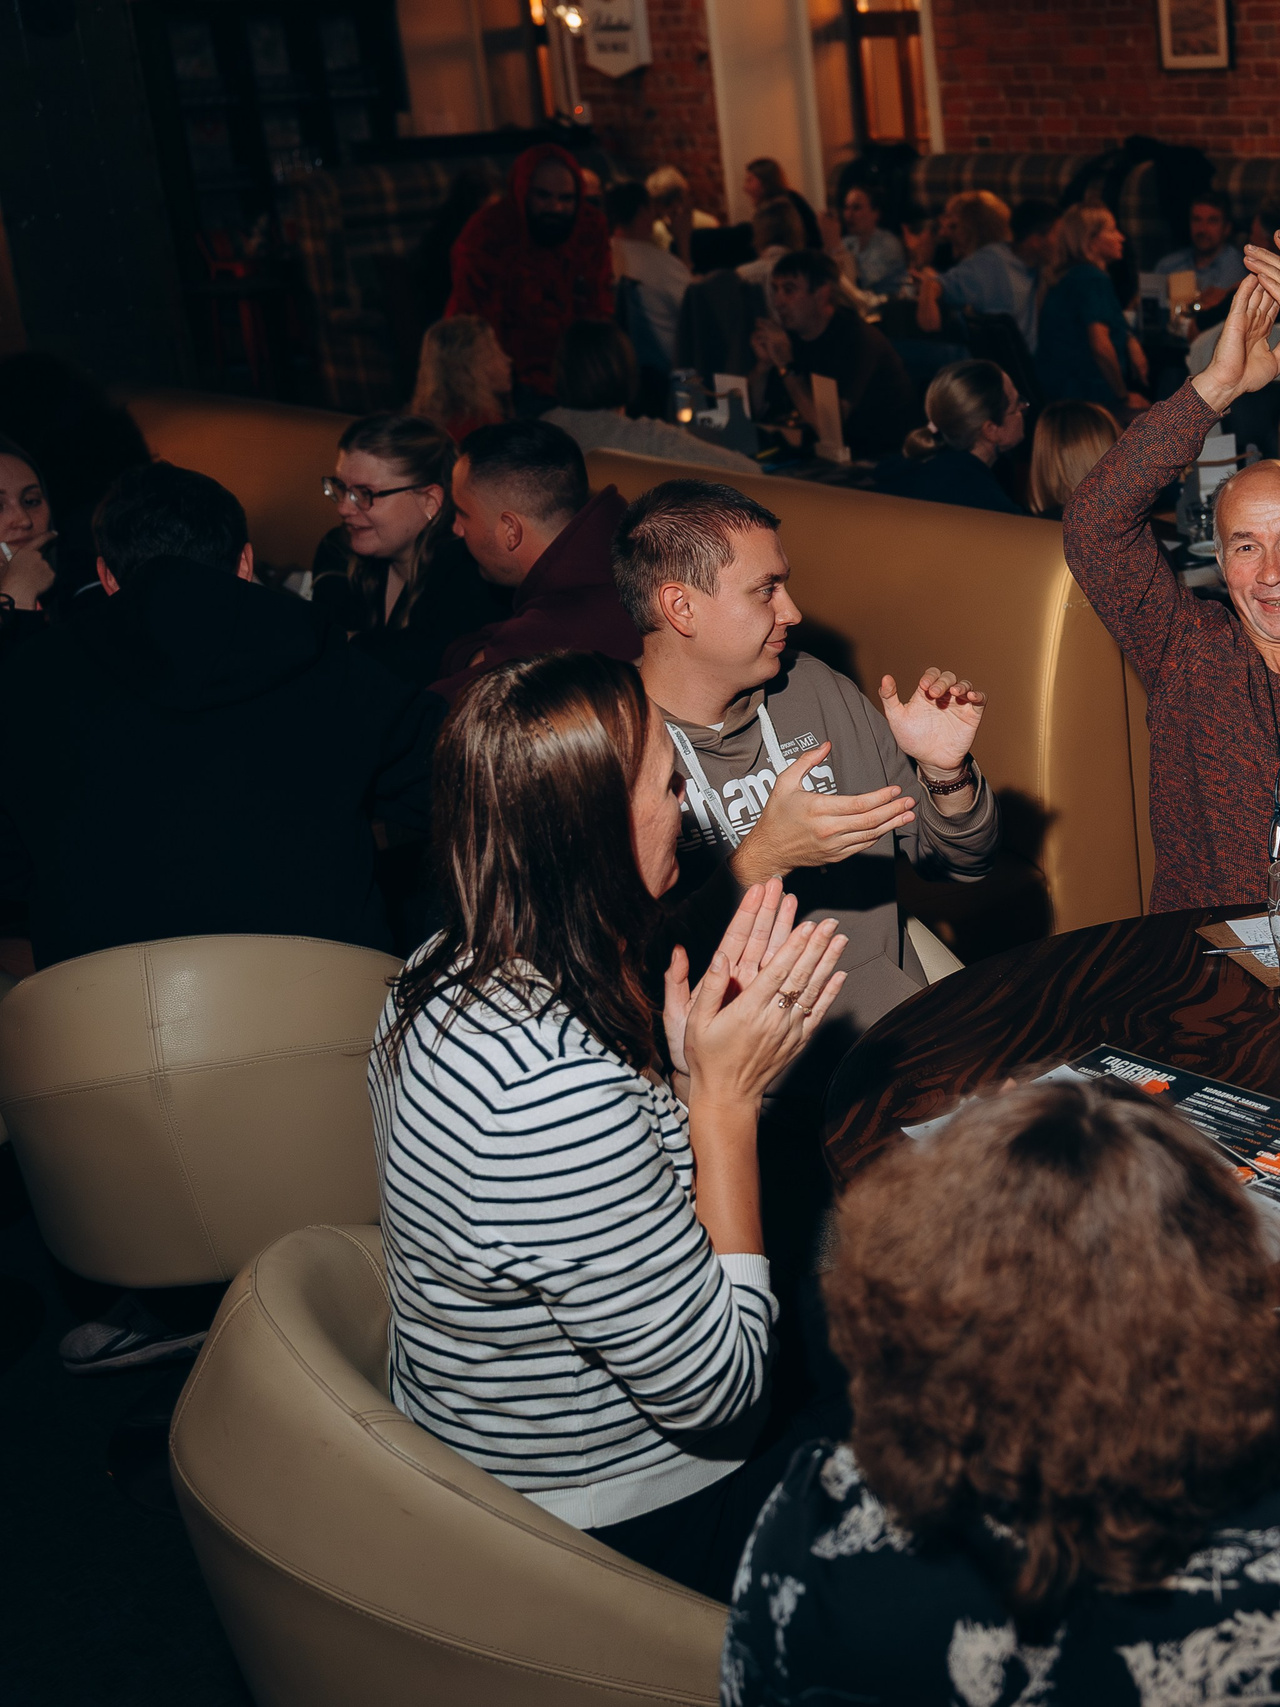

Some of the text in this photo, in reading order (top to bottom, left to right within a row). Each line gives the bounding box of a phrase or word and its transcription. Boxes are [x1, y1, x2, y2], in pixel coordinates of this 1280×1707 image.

[799, 734, 815, 749] MF
[1100, 1056, 1177, 1082] ГАСТРОБАР
[1202, 1086, 1240, 1102] ХОЛОДНЫЕ
[1238, 1096, 1270, 1111] ЗАКУСКИ
